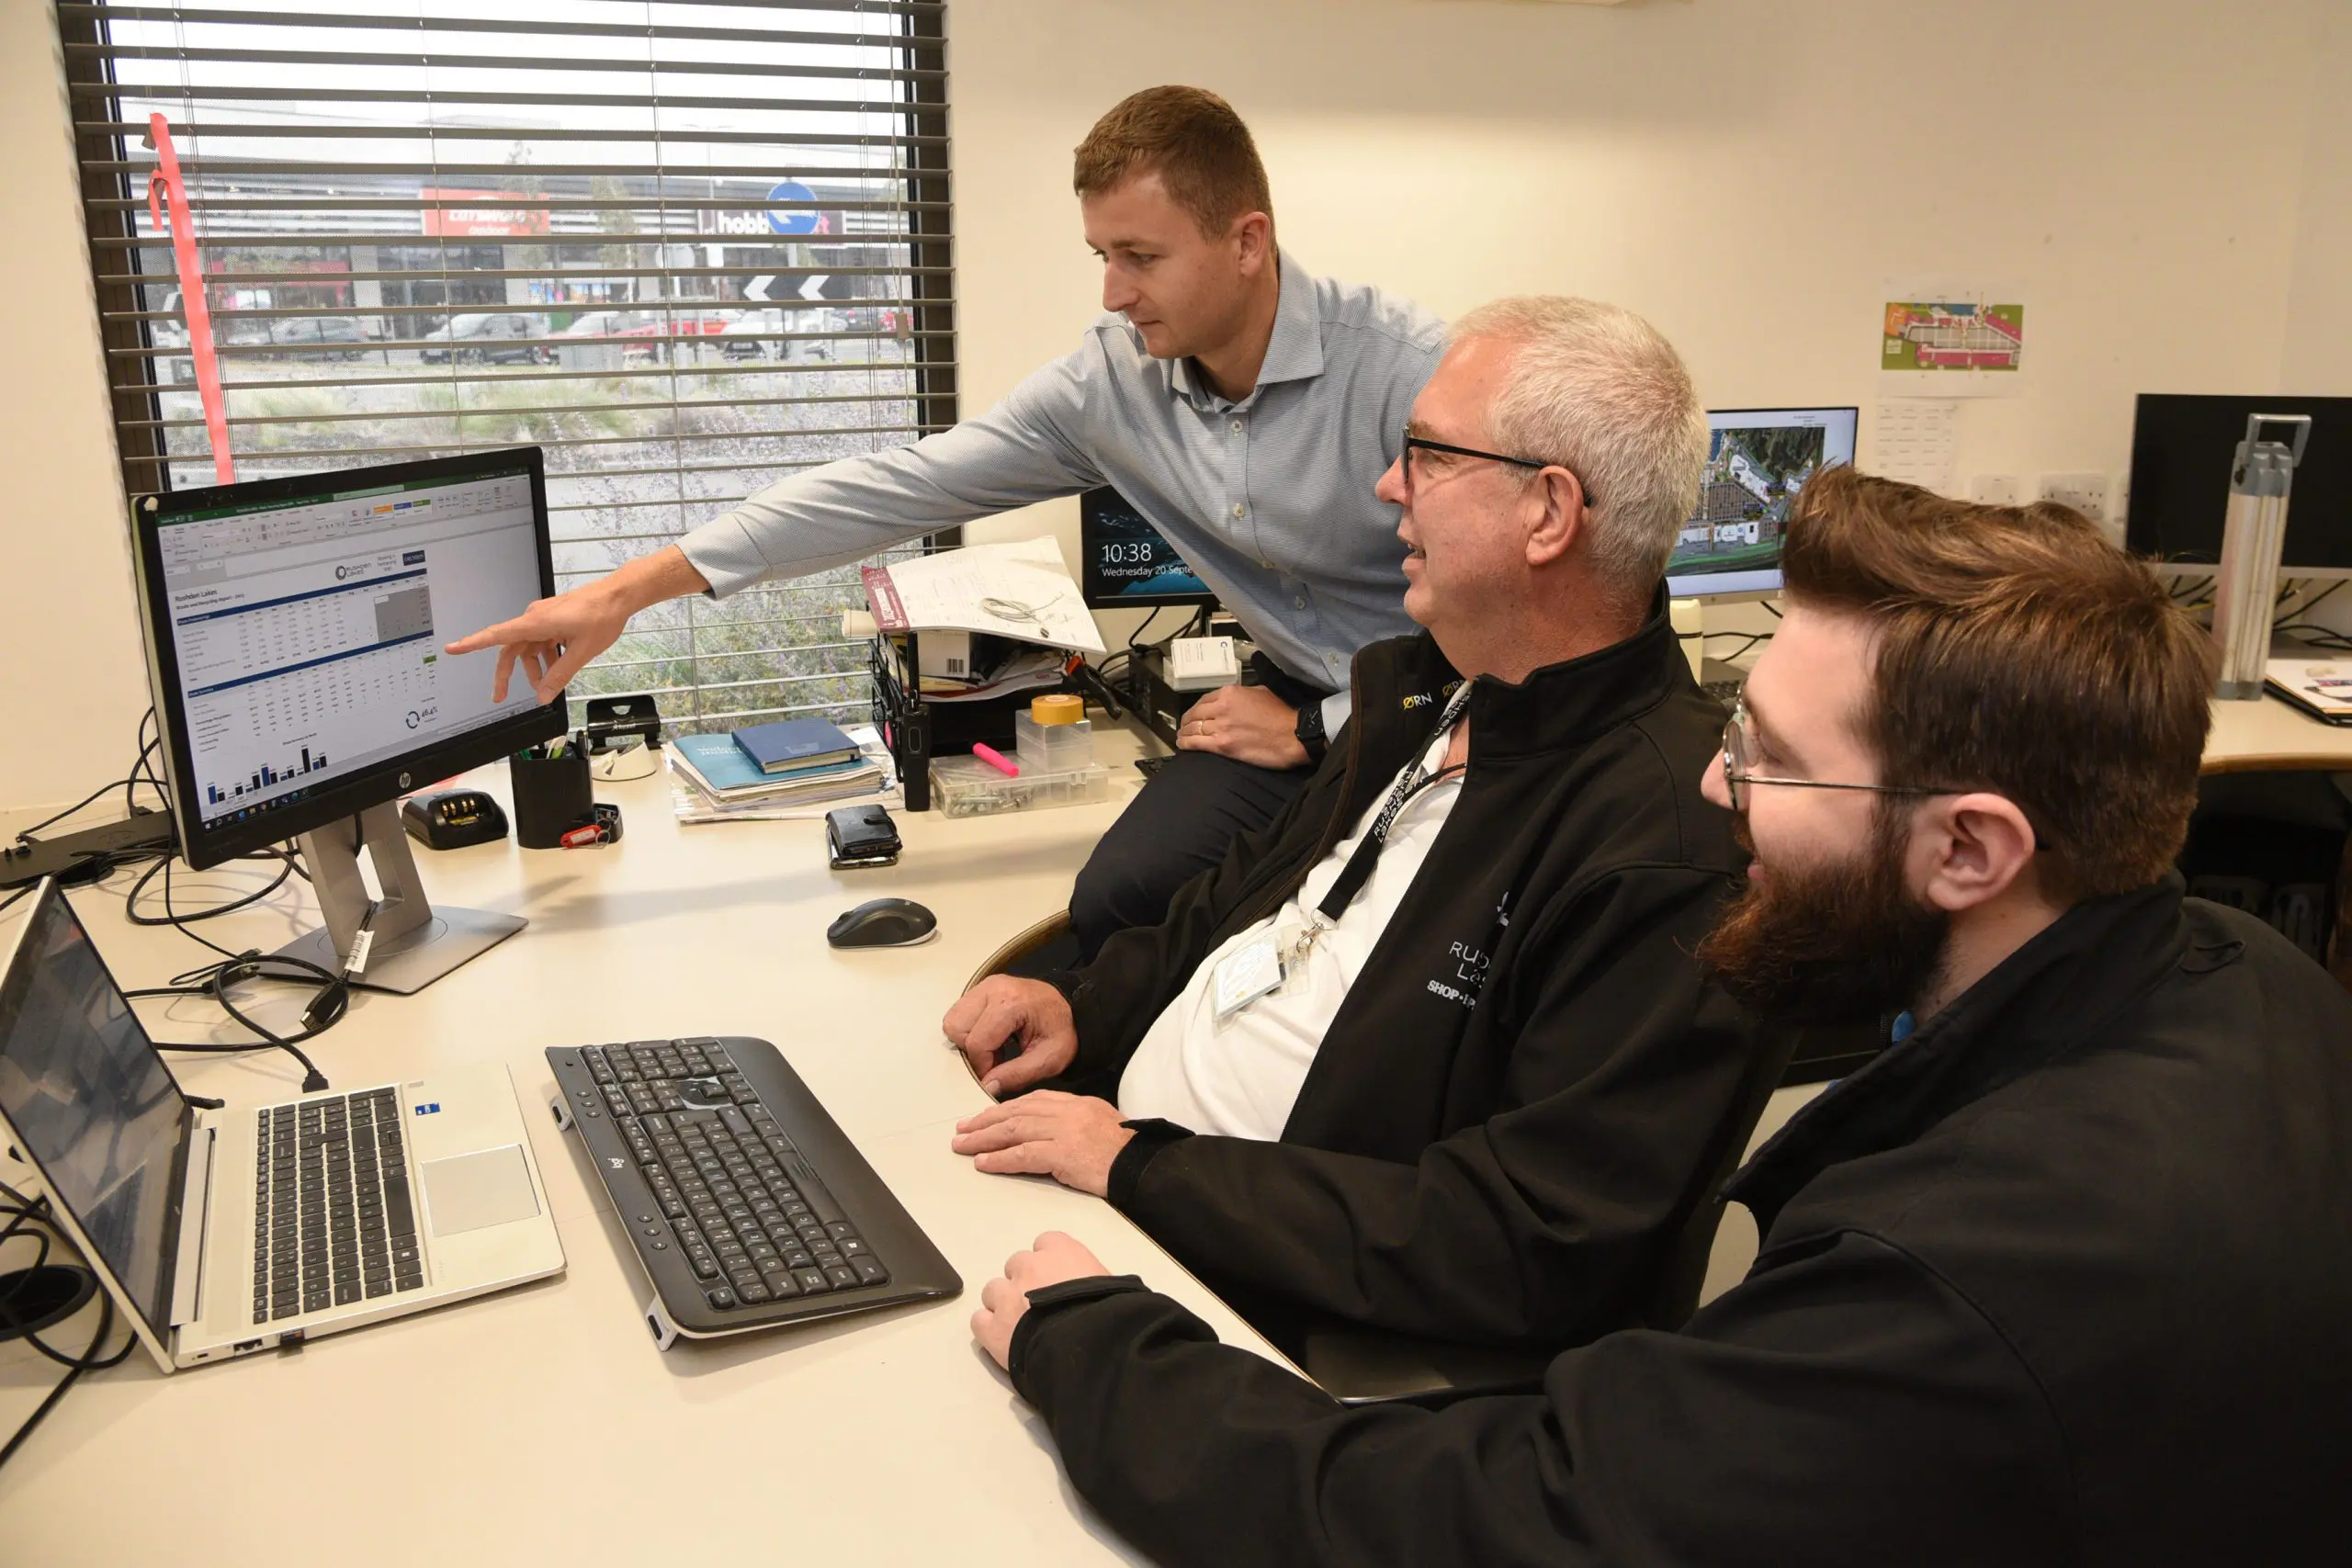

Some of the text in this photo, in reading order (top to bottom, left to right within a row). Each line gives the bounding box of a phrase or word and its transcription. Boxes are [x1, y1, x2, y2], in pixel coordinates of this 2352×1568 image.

[1102, 543, 1152, 563] 10:38
[1102, 565, 1193, 577] Wednesday 20 Septe
[1403, 692, 1433, 710] ØRN
